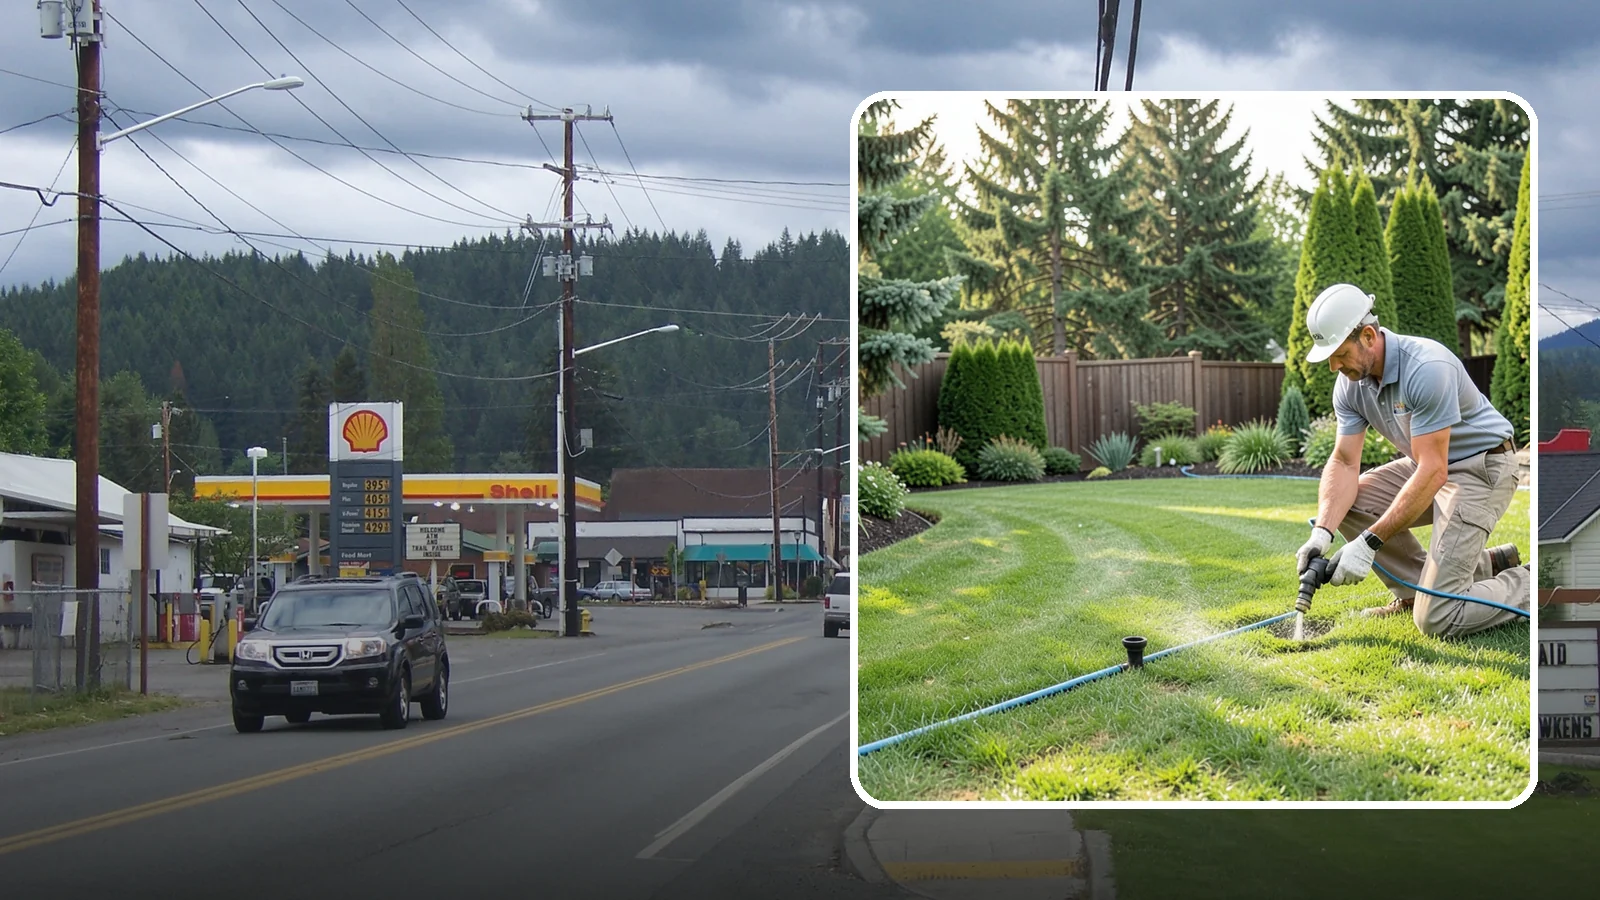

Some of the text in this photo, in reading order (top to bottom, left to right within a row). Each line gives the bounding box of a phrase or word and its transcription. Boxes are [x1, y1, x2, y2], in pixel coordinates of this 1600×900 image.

[366, 480, 384, 490] 395
[490, 484, 547, 499] Shell
[366, 494, 384, 504] 405
[366, 508, 384, 518] 415
[366, 522, 384, 532] 429
